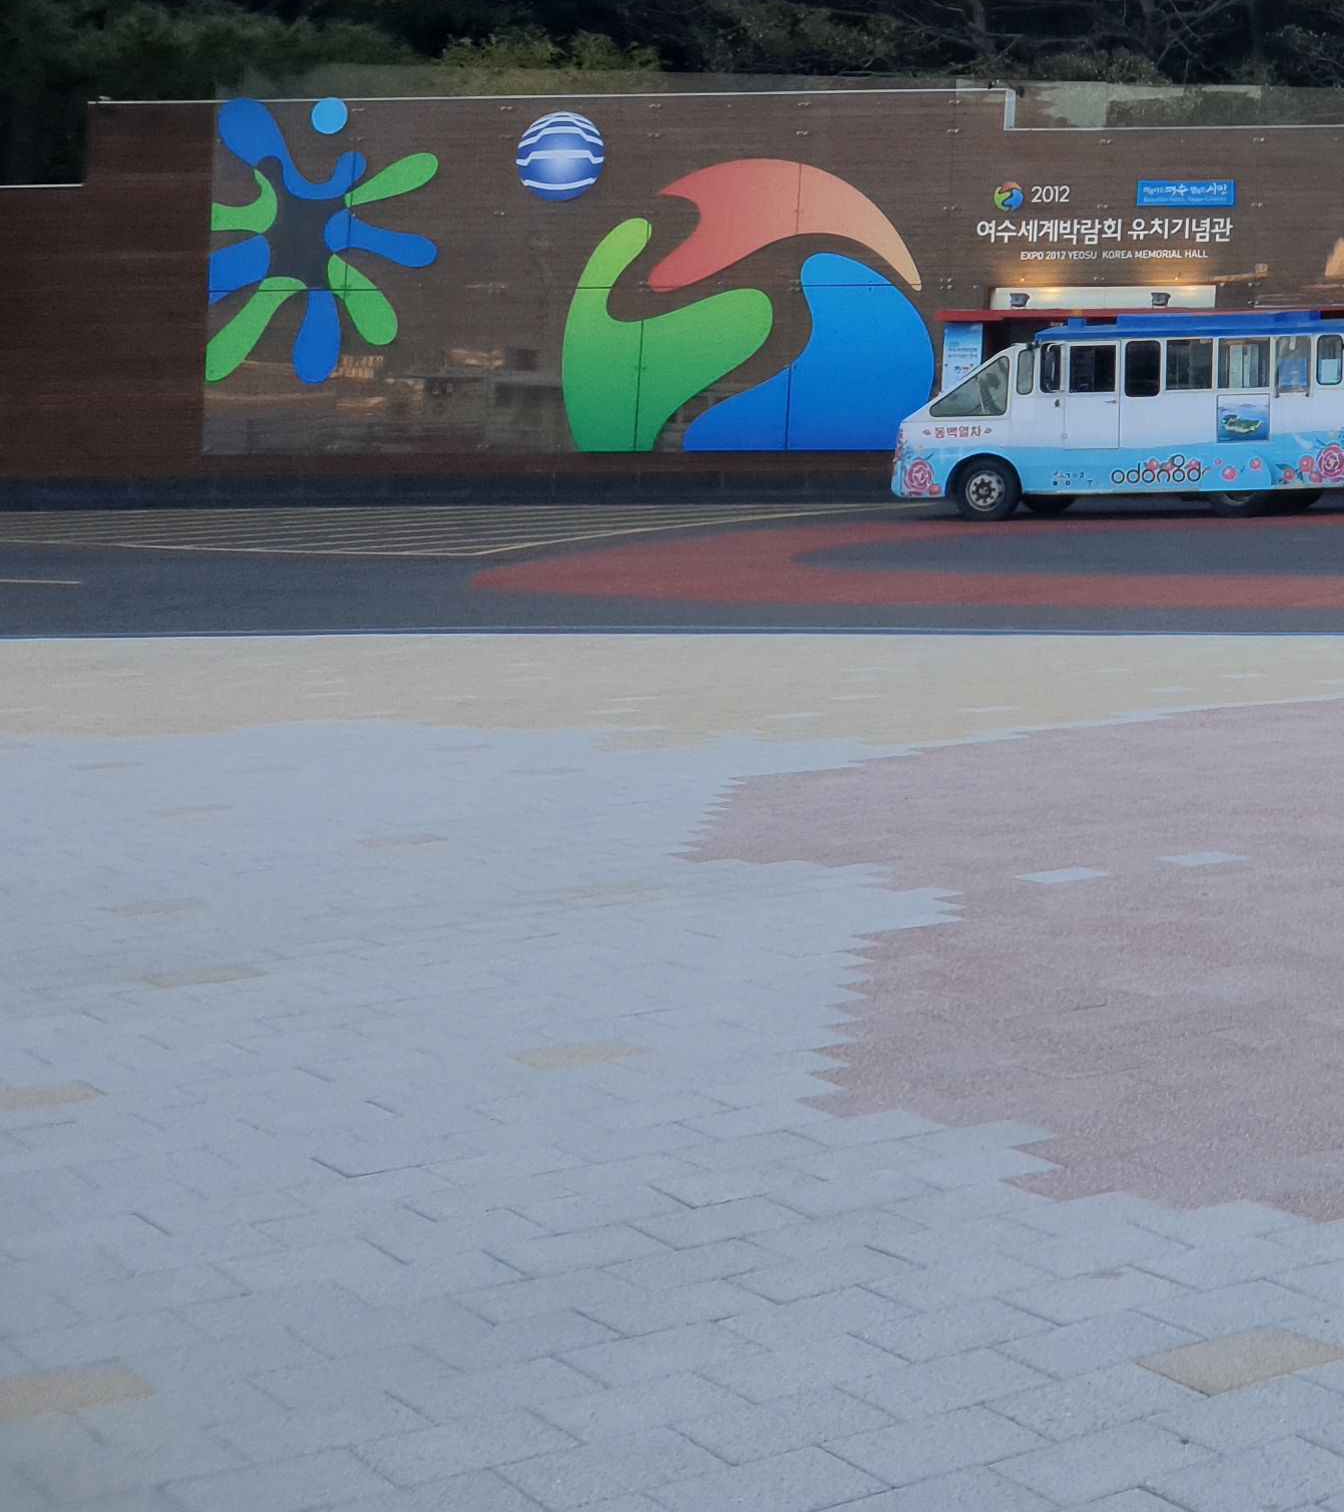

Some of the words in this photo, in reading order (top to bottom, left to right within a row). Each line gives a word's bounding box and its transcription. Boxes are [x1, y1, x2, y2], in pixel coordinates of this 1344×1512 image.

[1030, 185, 1071, 203] 2012
[976, 217, 1123, 245] 여수세계박람회
[1127, 216, 1233, 243] 유치기념관
[1020, 251, 1044, 260] EXPO
[1045, 251, 1067, 260] 2012
[1068, 250, 1097, 260] YEOSU
[1102, 250, 1133, 260] KOREA
[1134, 249, 1183, 259] MEMORIAL
[1184, 249, 1209, 259] HALL
[934, 426, 981, 439] 동백열차
